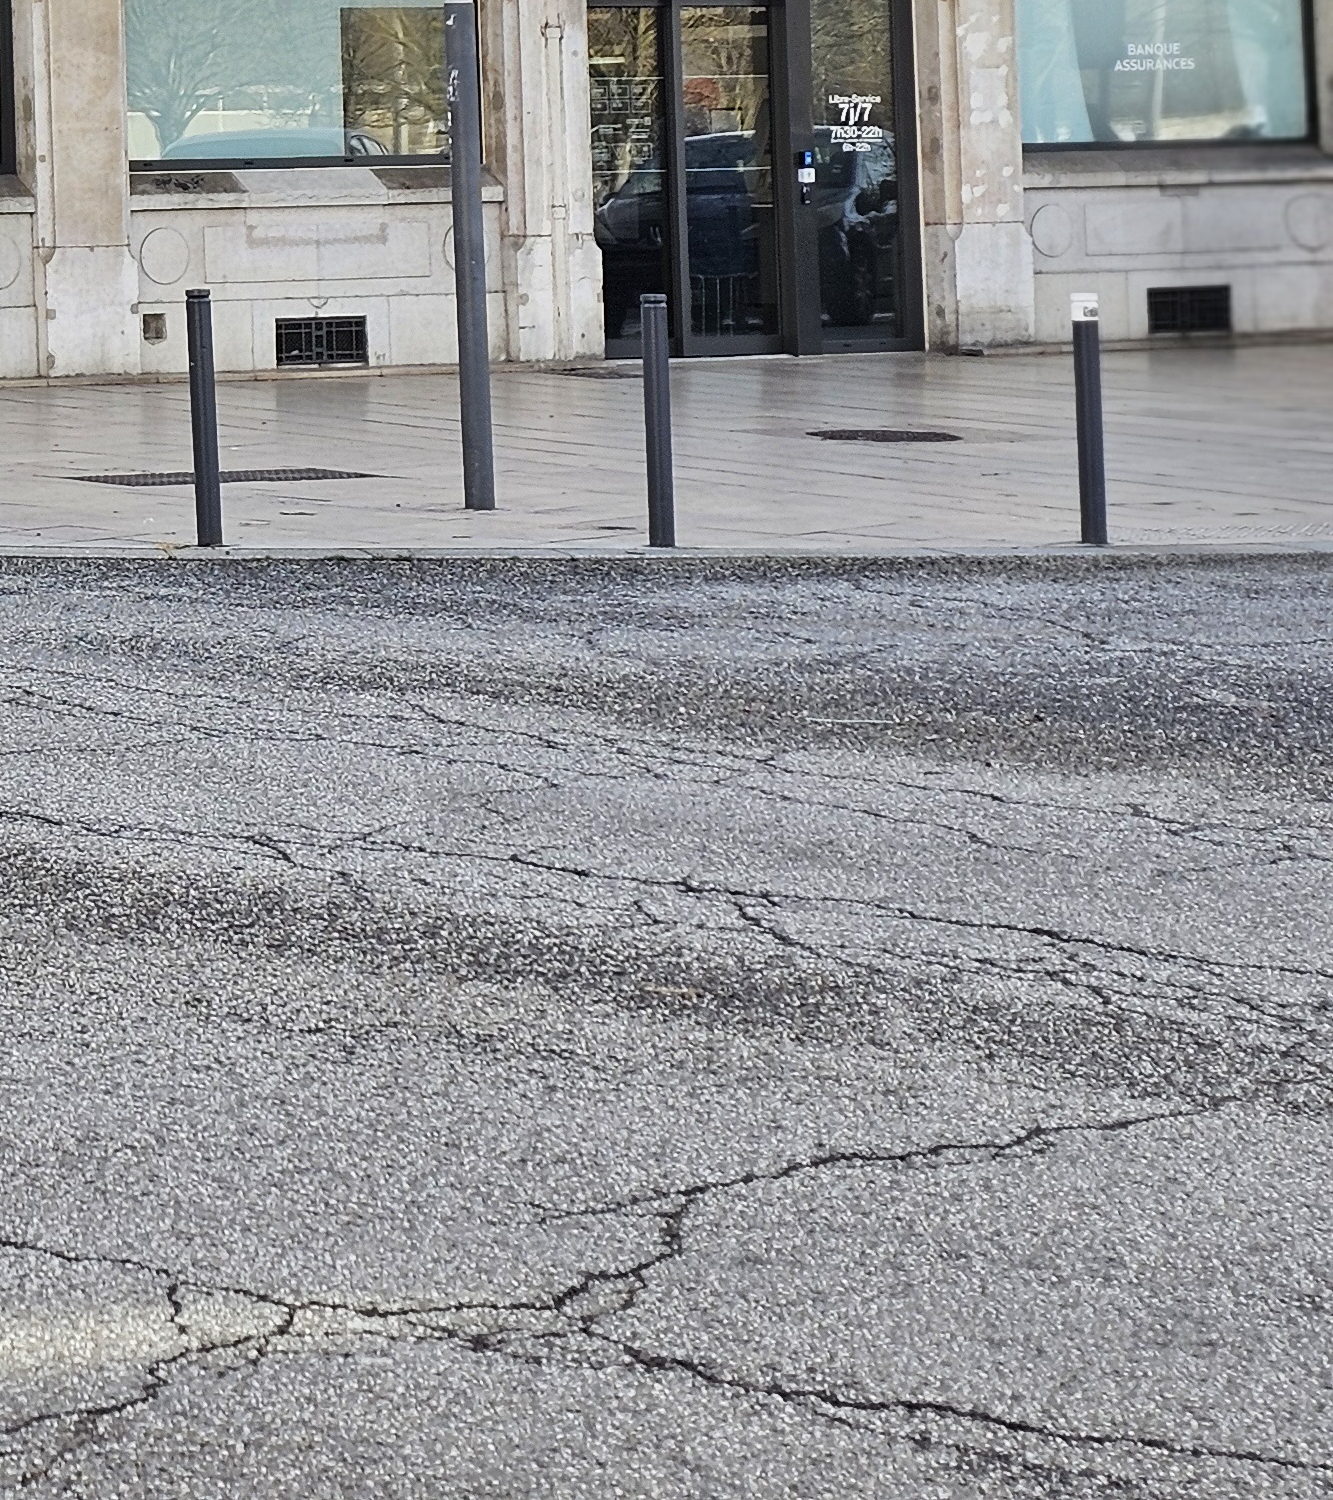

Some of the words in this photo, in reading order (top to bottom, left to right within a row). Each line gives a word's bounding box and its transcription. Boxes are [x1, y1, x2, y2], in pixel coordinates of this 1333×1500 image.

[1127, 42, 1181, 56] BANQUE
[1113, 57, 1196, 72] ASSURANCES
[838, 102, 873, 126] 7j/7
